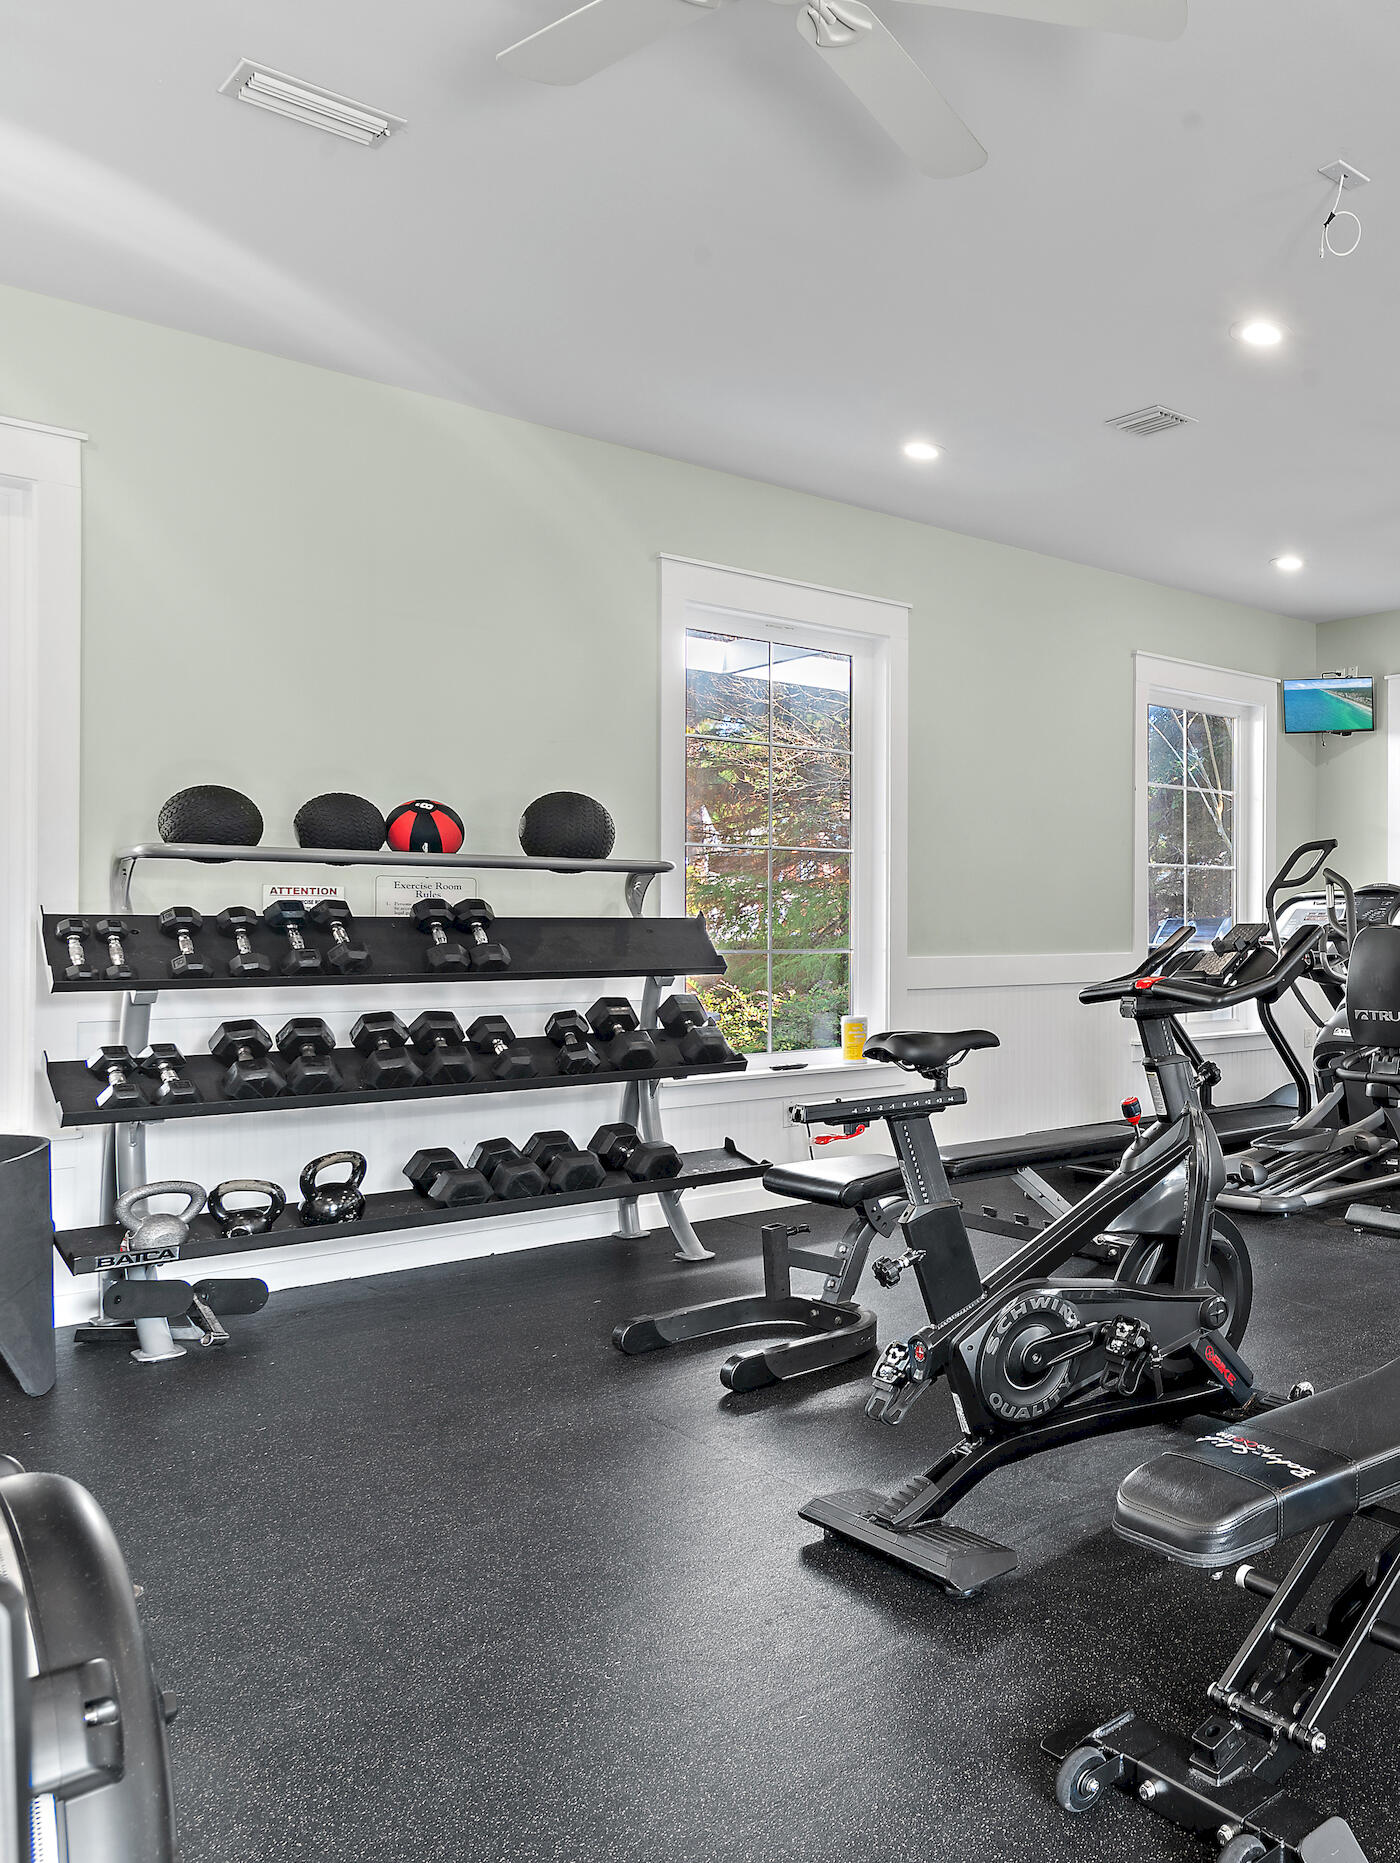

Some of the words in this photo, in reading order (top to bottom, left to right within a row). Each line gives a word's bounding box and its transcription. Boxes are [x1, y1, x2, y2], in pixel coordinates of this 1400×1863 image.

[269, 886, 338, 896] ATTENTION
[393, 881, 433, 890] Exercise
[435, 882, 463, 891] Room
[415, 890, 442, 898] Rules
[97, 1248, 176, 1268] BATCA
[988, 1373, 1072, 1420] QUALITY
